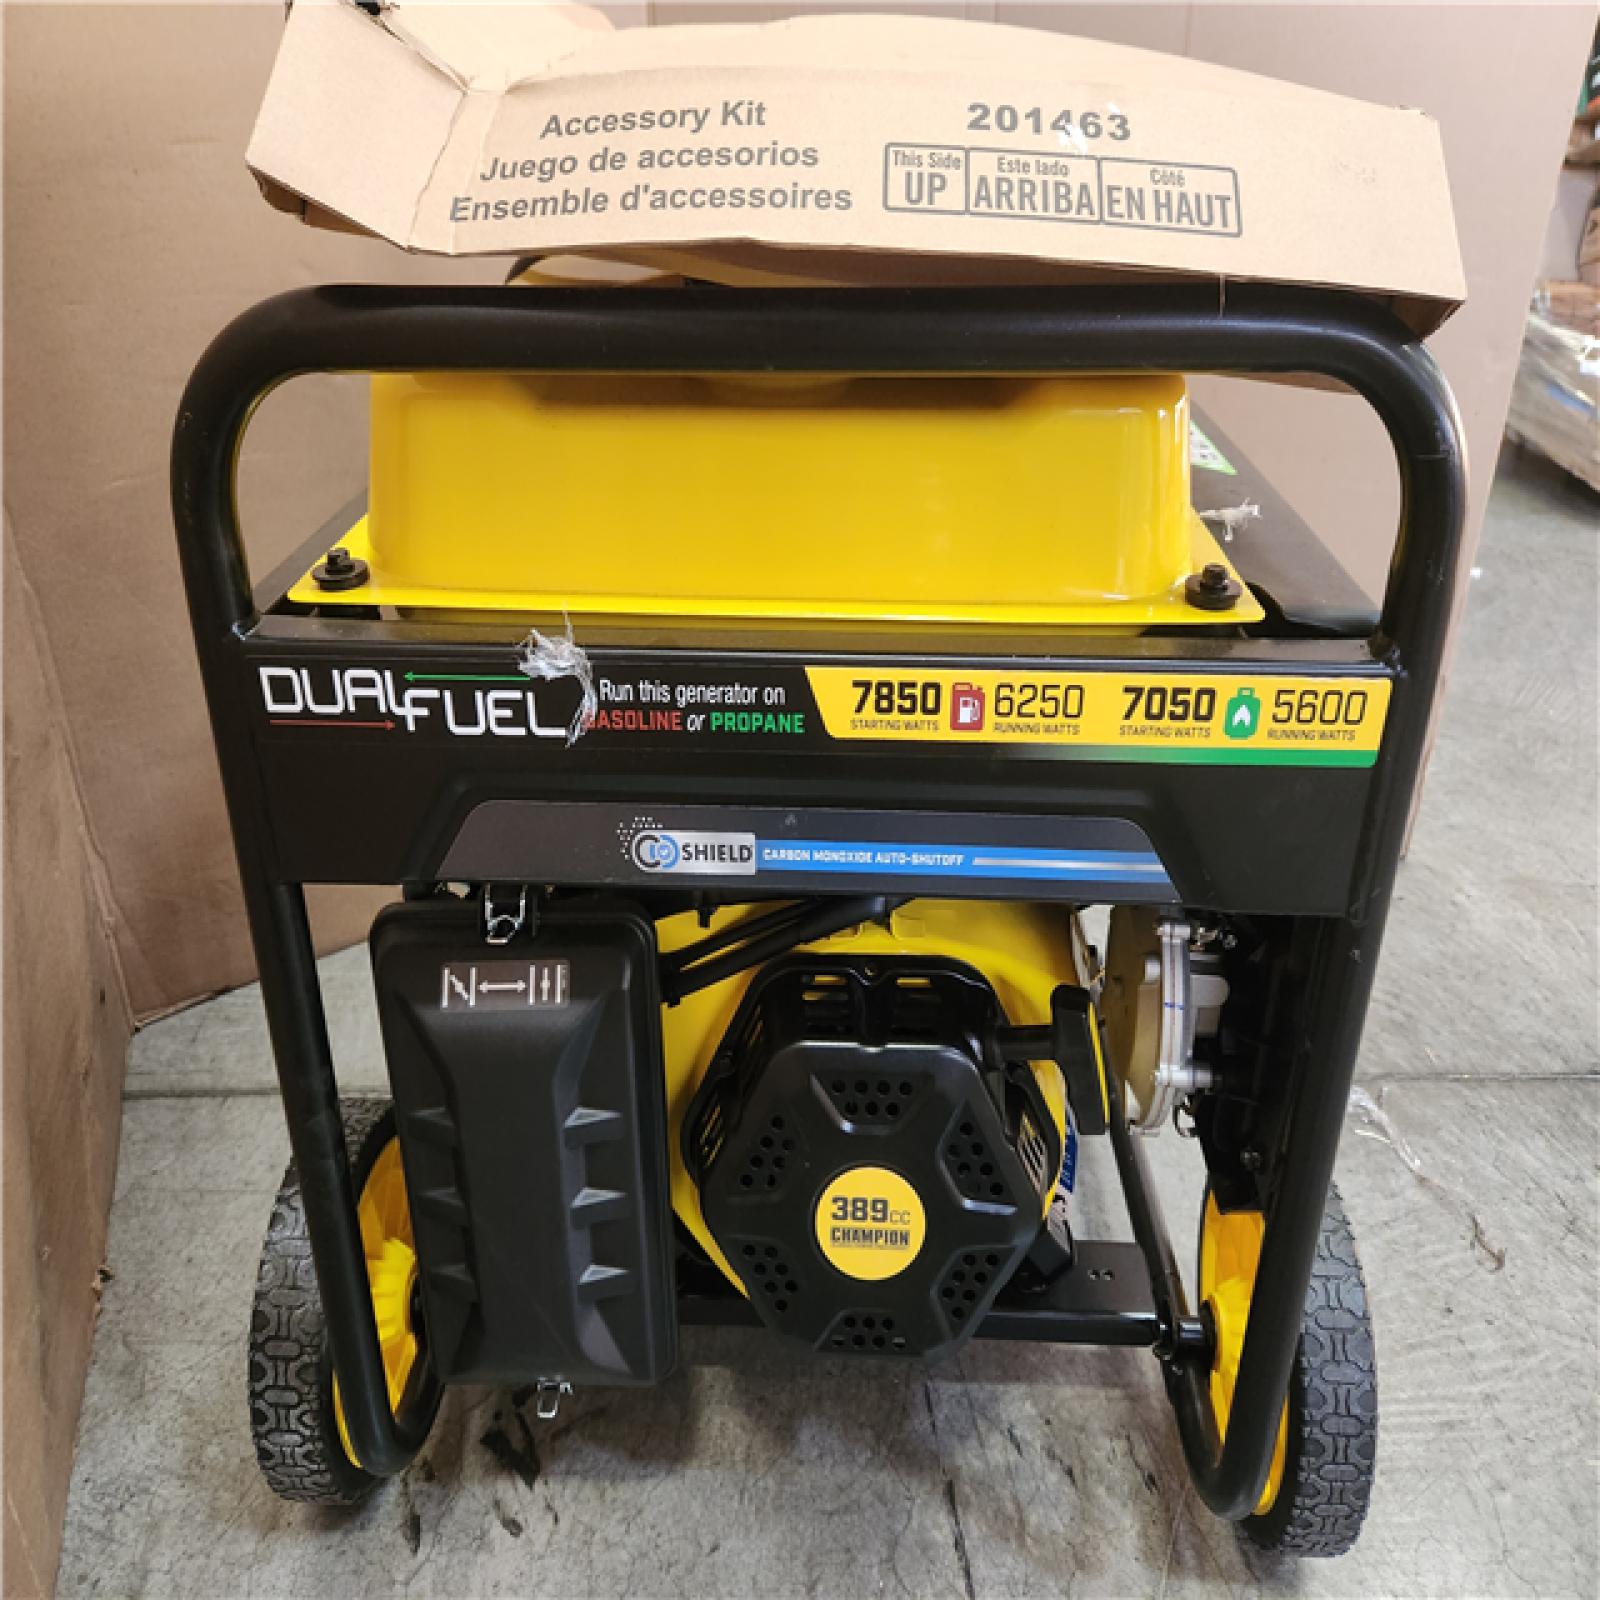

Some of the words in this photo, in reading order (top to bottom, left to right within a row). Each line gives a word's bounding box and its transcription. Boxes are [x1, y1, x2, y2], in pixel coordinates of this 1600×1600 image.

[540, 107, 710, 139] Accessory
[721, 100, 766, 126] Kit
[967, 102, 1131, 141] 201463
[480, 154, 578, 182] Juego
[588, 147, 626, 172] de
[637, 141, 819, 170] accesorios
[893, 150, 923, 168] This
[928, 152, 961, 170] Side
[997, 157, 1031, 174] Este
[1035, 160, 1070, 177] lado
[450, 187, 608, 222] Ensemble
[620, 182, 853, 211] d'accessoires
[905, 171, 947, 206] UP
[974, 175, 1096, 216] ARRIBA
[1106, 185, 1146, 221] EN
[1153, 189, 1231, 229] HAUT
[259, 667, 404, 716] DUAL
[400, 689, 567, 736] FUEL
[600, 680, 633, 701] Run
[638, 680, 671, 703] this
[674, 682, 758, 708] generator
[763, 686, 786, 705] on
[852, 680, 941, 715] 7850
[994, 683, 1085, 719] 6250
[1122, 686, 1216, 721] 7050
[1272, 690, 1368, 725] 5600
[687, 714, 705, 732] or
[709, 712, 805, 733] PROPANE
[850, 719, 901, 731] STARTING
[903, 720, 940, 732] WATTS
[993, 722, 1041, 734] RUNNING
[1043, 723, 1081, 735] WATTS
[1119, 725, 1172, 737] STARTING
[1174, 726, 1211, 738] WATTS
[1318, 730, 1356, 741] WATTS
[682, 843, 753, 862] SHIELD
[764, 848, 811, 861] CARBON
[813, 850, 873, 864] MONOXIDE
[874, 851, 965, 866] AUTO-SHUTOFF
[831, 1227, 911, 1246] CHAMPION
